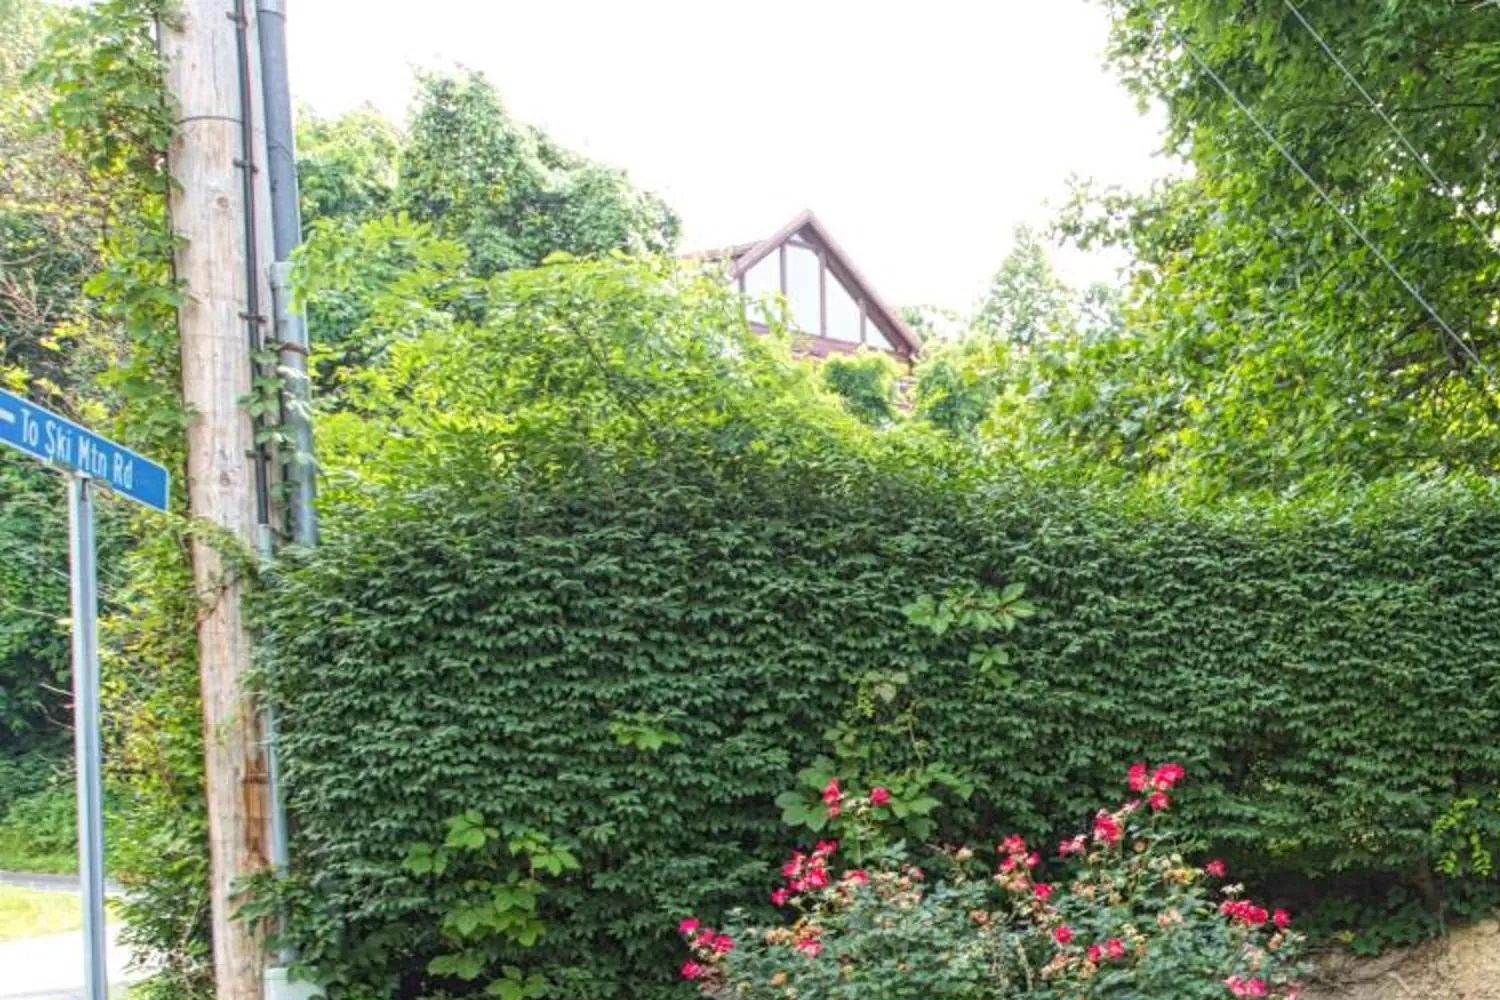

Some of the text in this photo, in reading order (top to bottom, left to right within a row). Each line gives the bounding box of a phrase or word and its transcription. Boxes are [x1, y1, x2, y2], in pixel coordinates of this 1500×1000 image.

[20, 408, 134, 489] To Ski Mtn Rd
